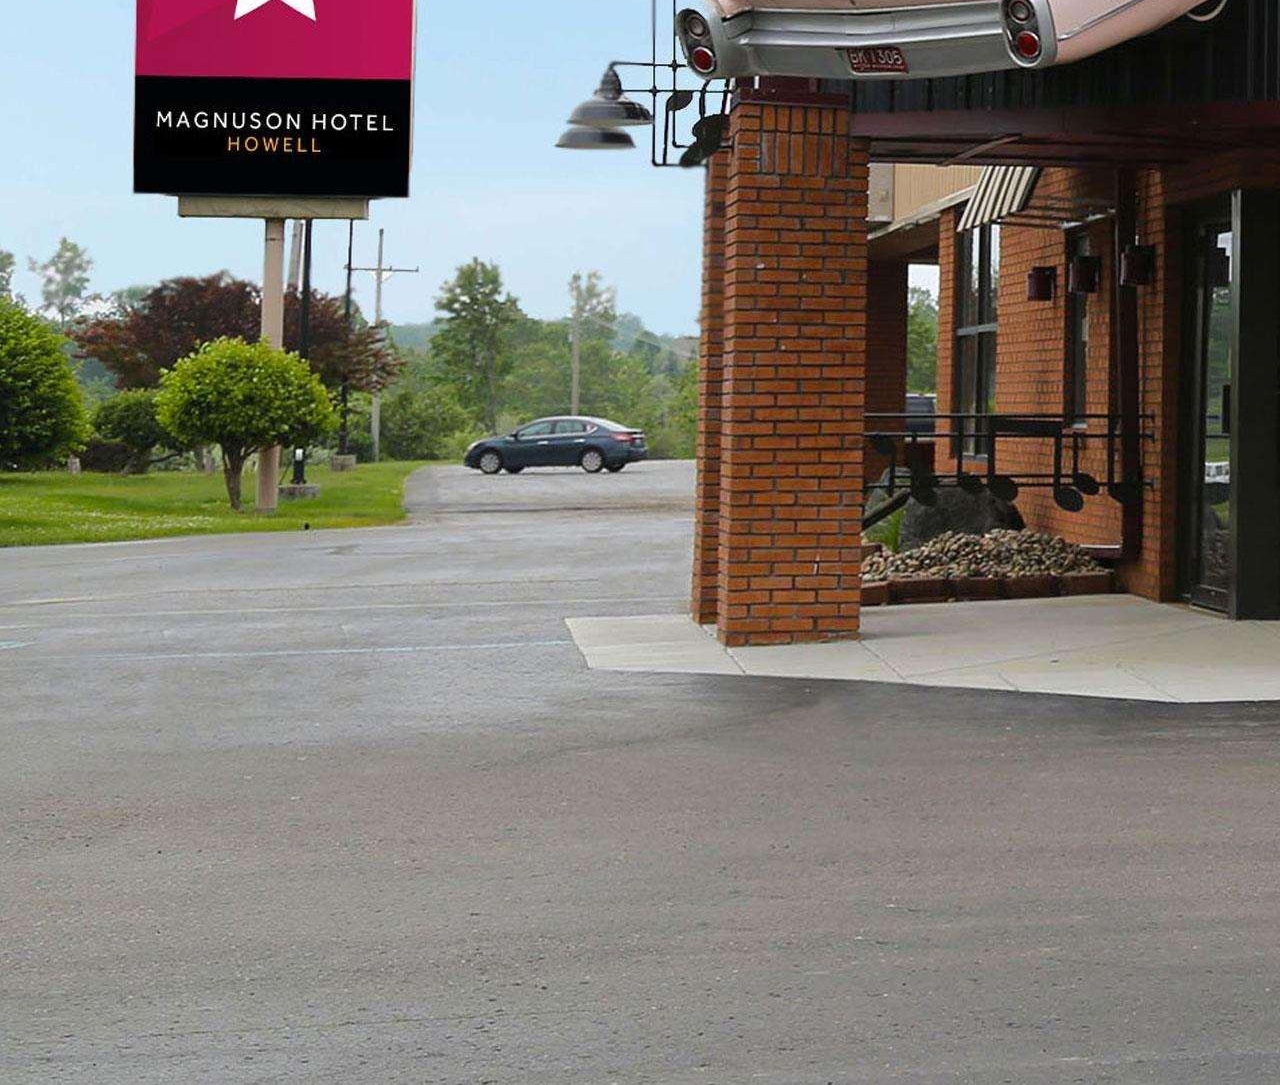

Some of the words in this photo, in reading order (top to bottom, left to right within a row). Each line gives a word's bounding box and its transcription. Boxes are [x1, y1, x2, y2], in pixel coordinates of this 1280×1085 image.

[156, 111, 301, 130] MAGNUSON
[312, 114, 394, 132] HOTEL
[227, 136, 322, 153] HOWELL
